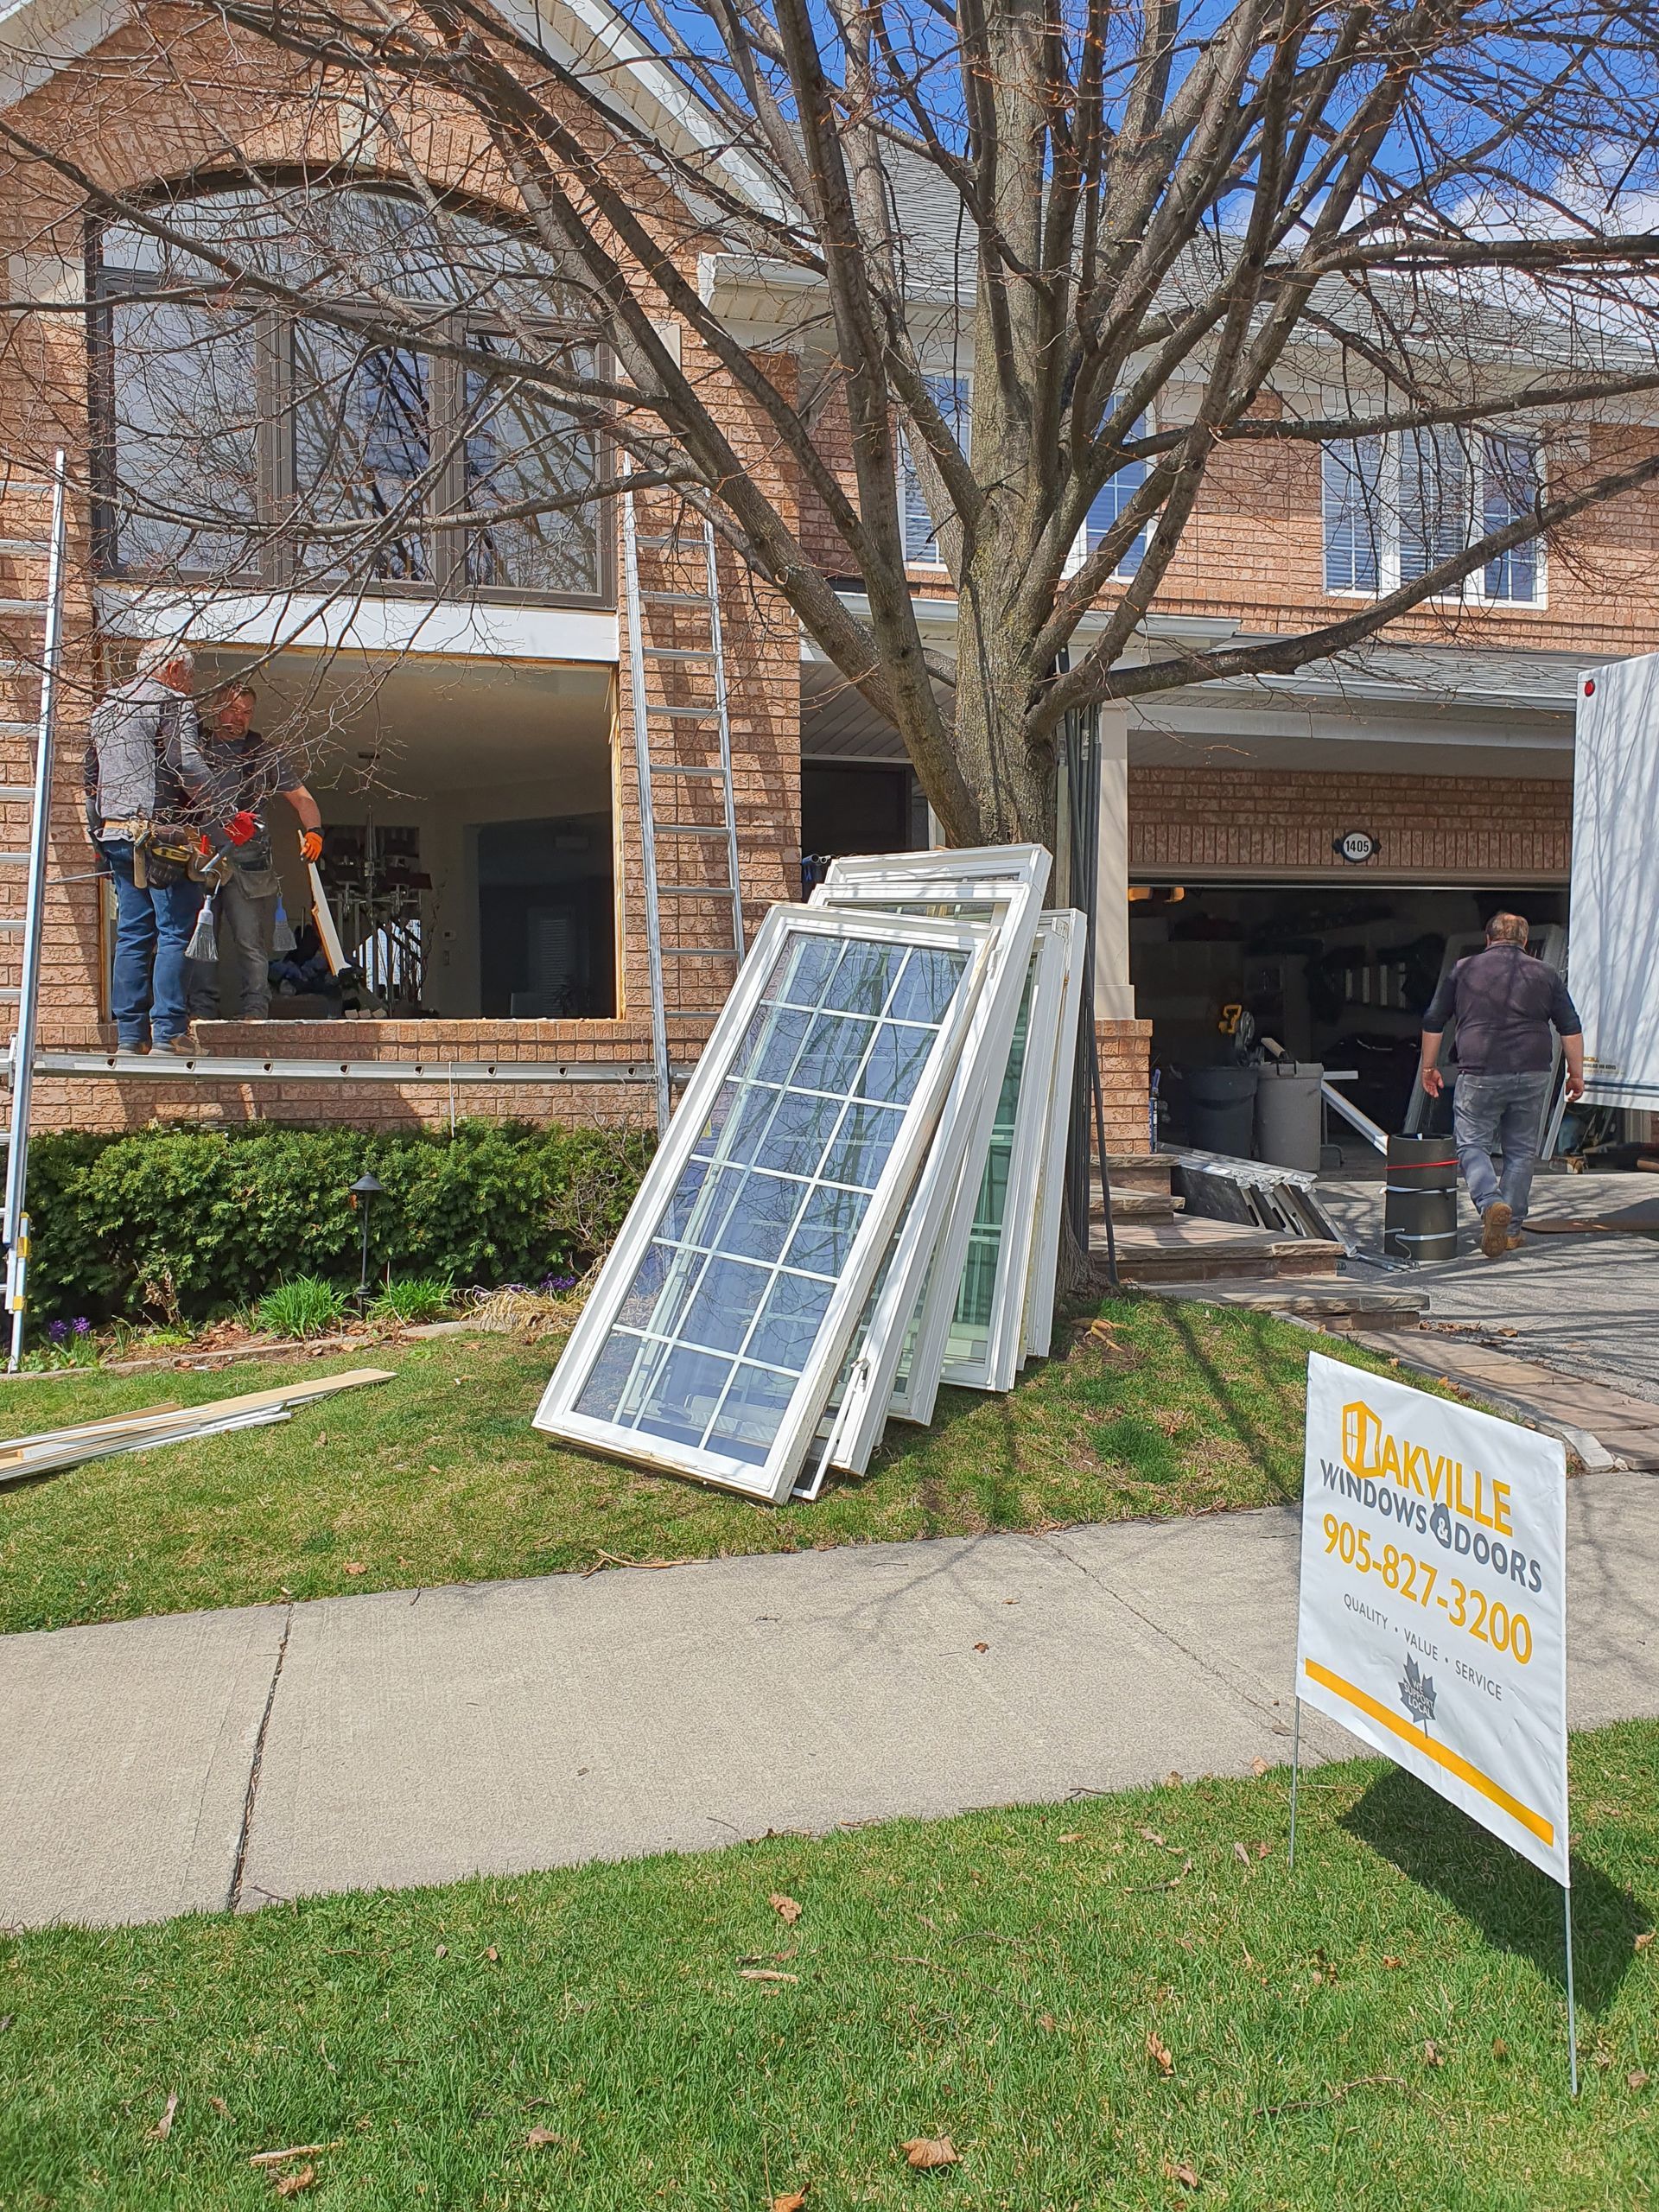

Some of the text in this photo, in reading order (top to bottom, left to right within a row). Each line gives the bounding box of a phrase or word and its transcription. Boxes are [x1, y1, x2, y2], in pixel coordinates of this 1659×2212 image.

[1345, 840, 1370, 853] 1405
[1320, 1459, 1427, 1534] WINDOWS
[1455, 1522, 1542, 1592] DOORS
[1323, 1513, 1533, 1666] 905-827-3200
[1344, 1593, 1503, 1701] QUALITY VALUE SERVICE
[1403, 1682, 1434, 1710] SUPPORT
[1411, 1678, 1424, 1694] WE
[1408, 1695, 1433, 1719] LOCAL
